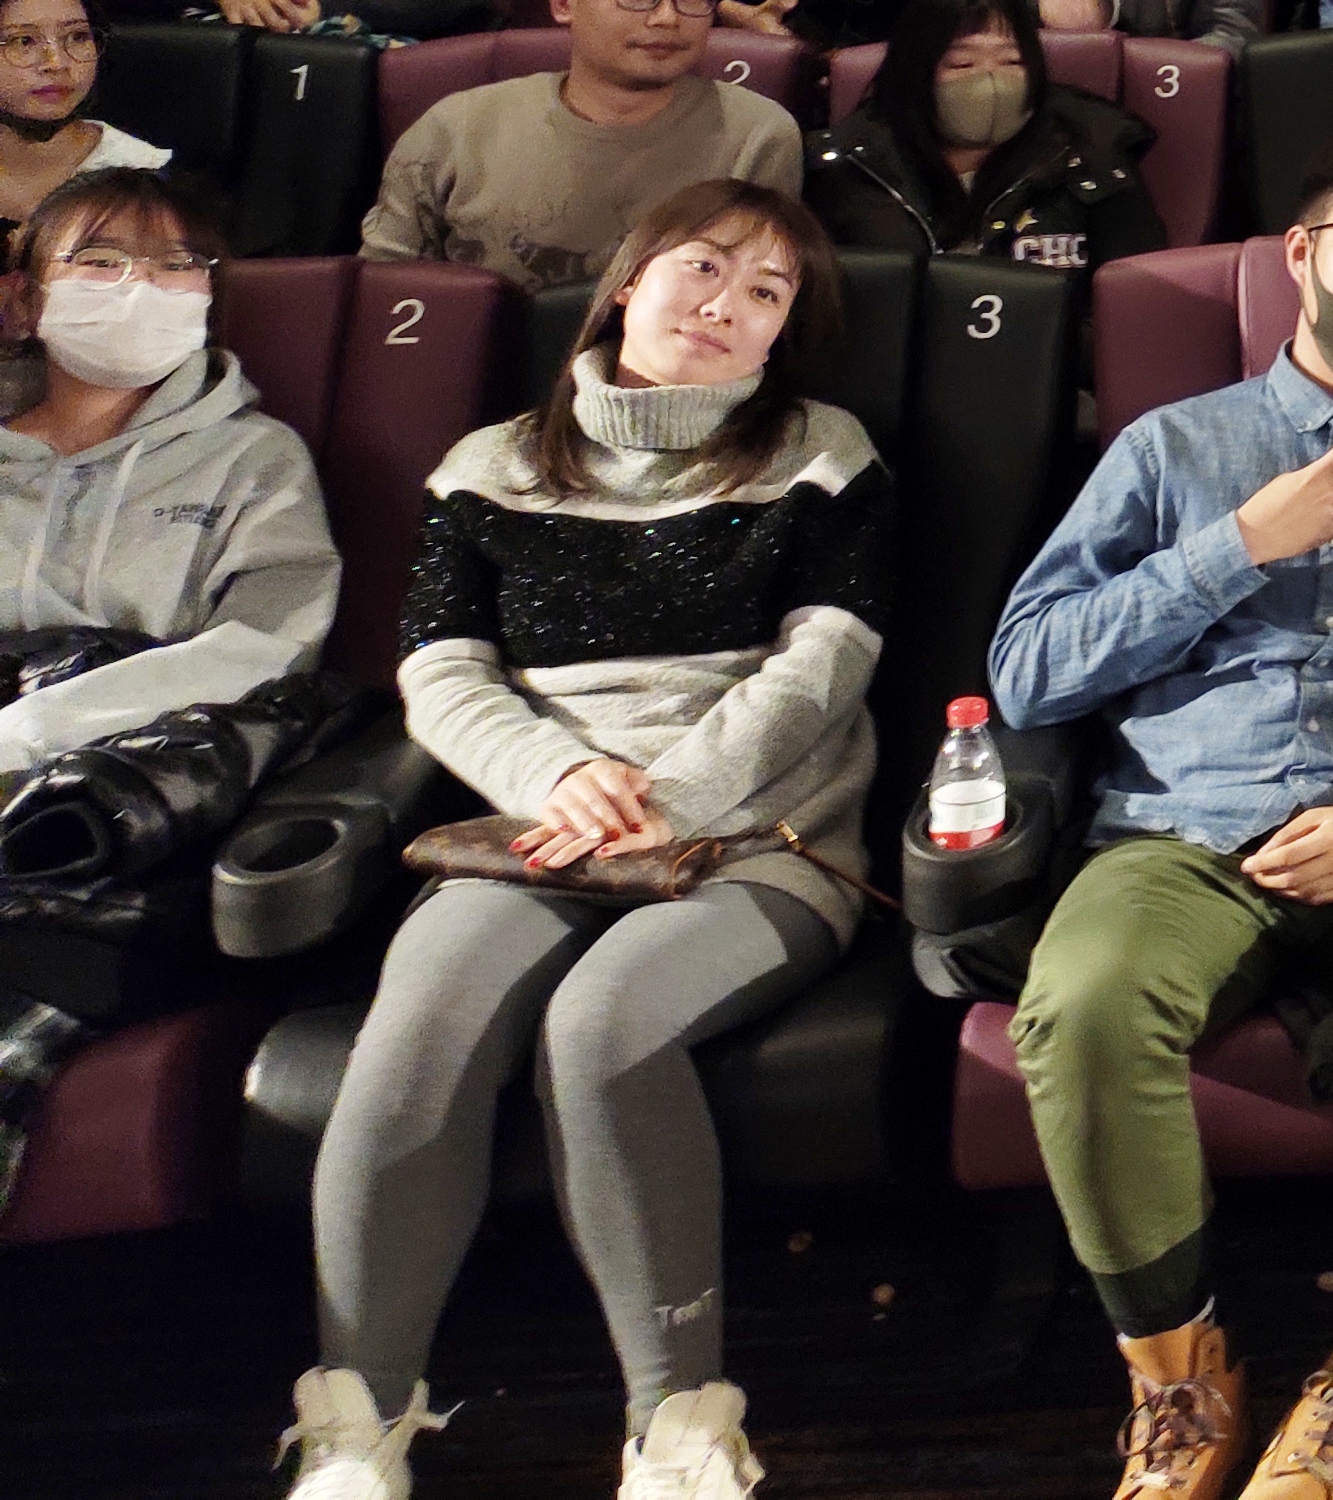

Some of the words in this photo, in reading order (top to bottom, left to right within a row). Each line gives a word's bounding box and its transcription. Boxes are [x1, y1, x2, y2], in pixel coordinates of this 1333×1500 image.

[290, 65, 309, 102] 1
[723, 60, 751, 86] 2
[1155, 65, 1181, 98] 3
[384, 298, 429, 345] 2
[967, 294, 1002, 340] 3
